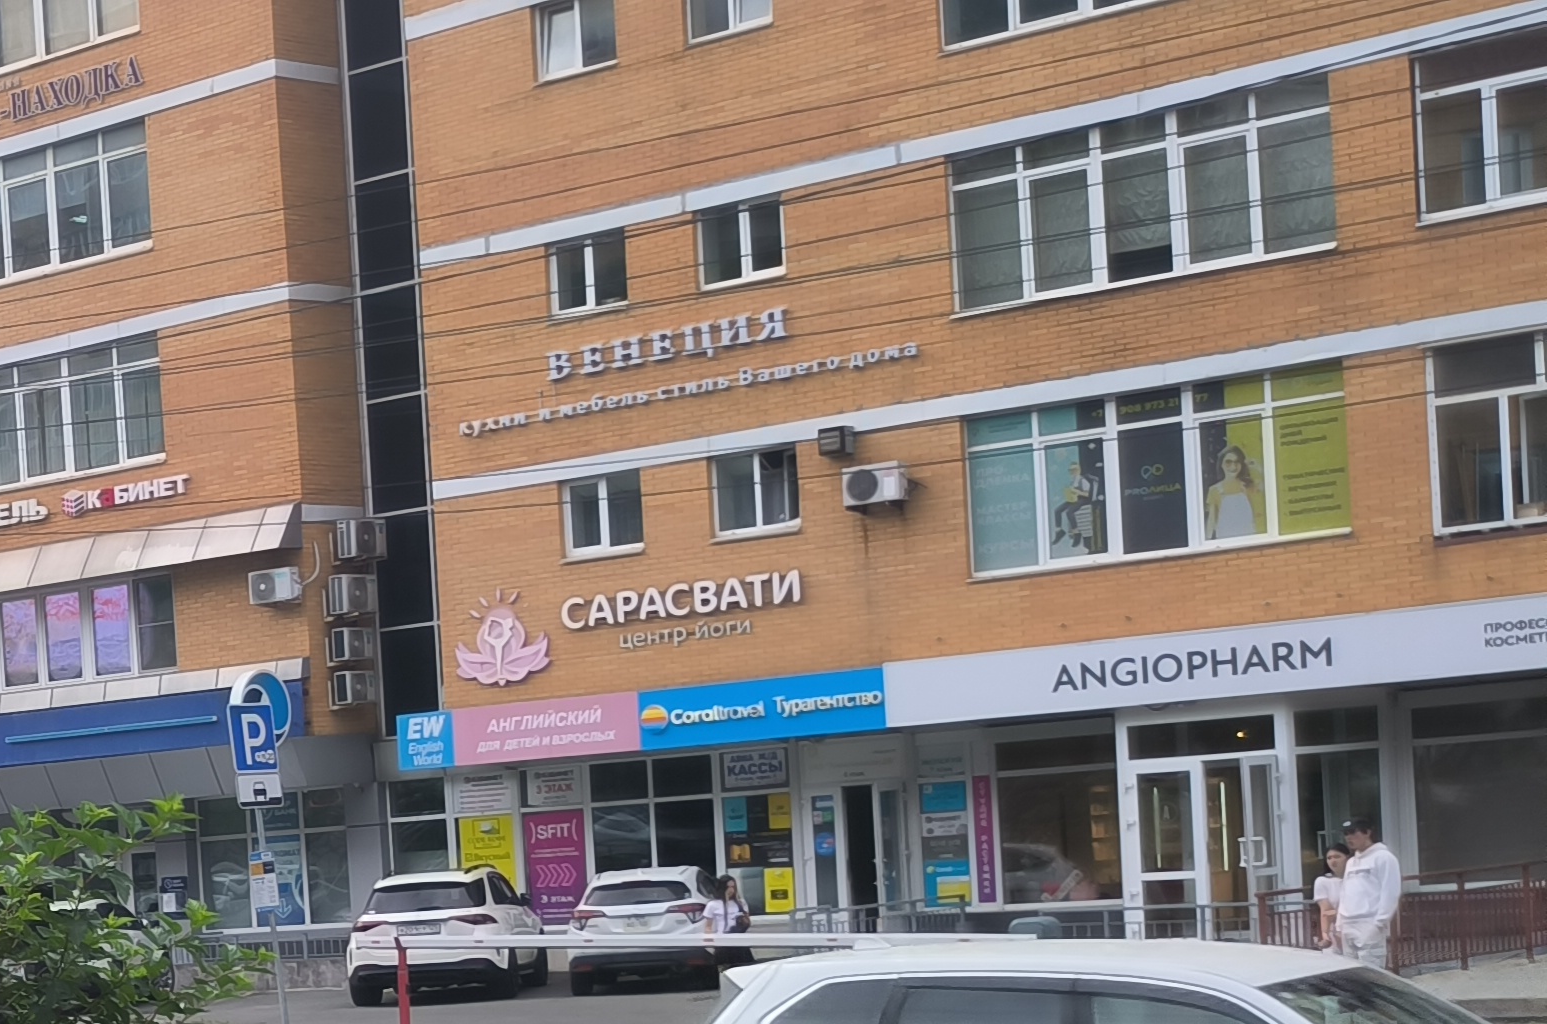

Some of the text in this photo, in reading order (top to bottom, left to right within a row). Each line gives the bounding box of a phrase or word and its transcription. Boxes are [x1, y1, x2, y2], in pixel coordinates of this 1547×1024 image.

[544, 305, 789, 382] ВЕНЕЦИЯ
[849, 341, 919, 370] дома
[560, 569, 801, 629] САРАСВАТИ
[619, 619, 752, 649] центр йоги
[1484, 618, 1547, 634] ПРОФЕС
[1485, 631, 1547, 648] КОСМЕТ
[1051, 636, 1333, 693] ANGIOPHARM
[772, 690, 883, 718] Турагентство
[407, 714, 446, 740] EW
[486, 704, 602, 733] АНГЛИЙСКИЙ
[240, 713, 266, 765] P
[408, 741, 444, 755] English
[503, 734, 540, 752] ДЕТЕЙ
[552, 730, 616, 746] ВЗРОСЛЫХ
[412, 753, 443, 766] World
[727, 760, 783, 778] КАССЫ
